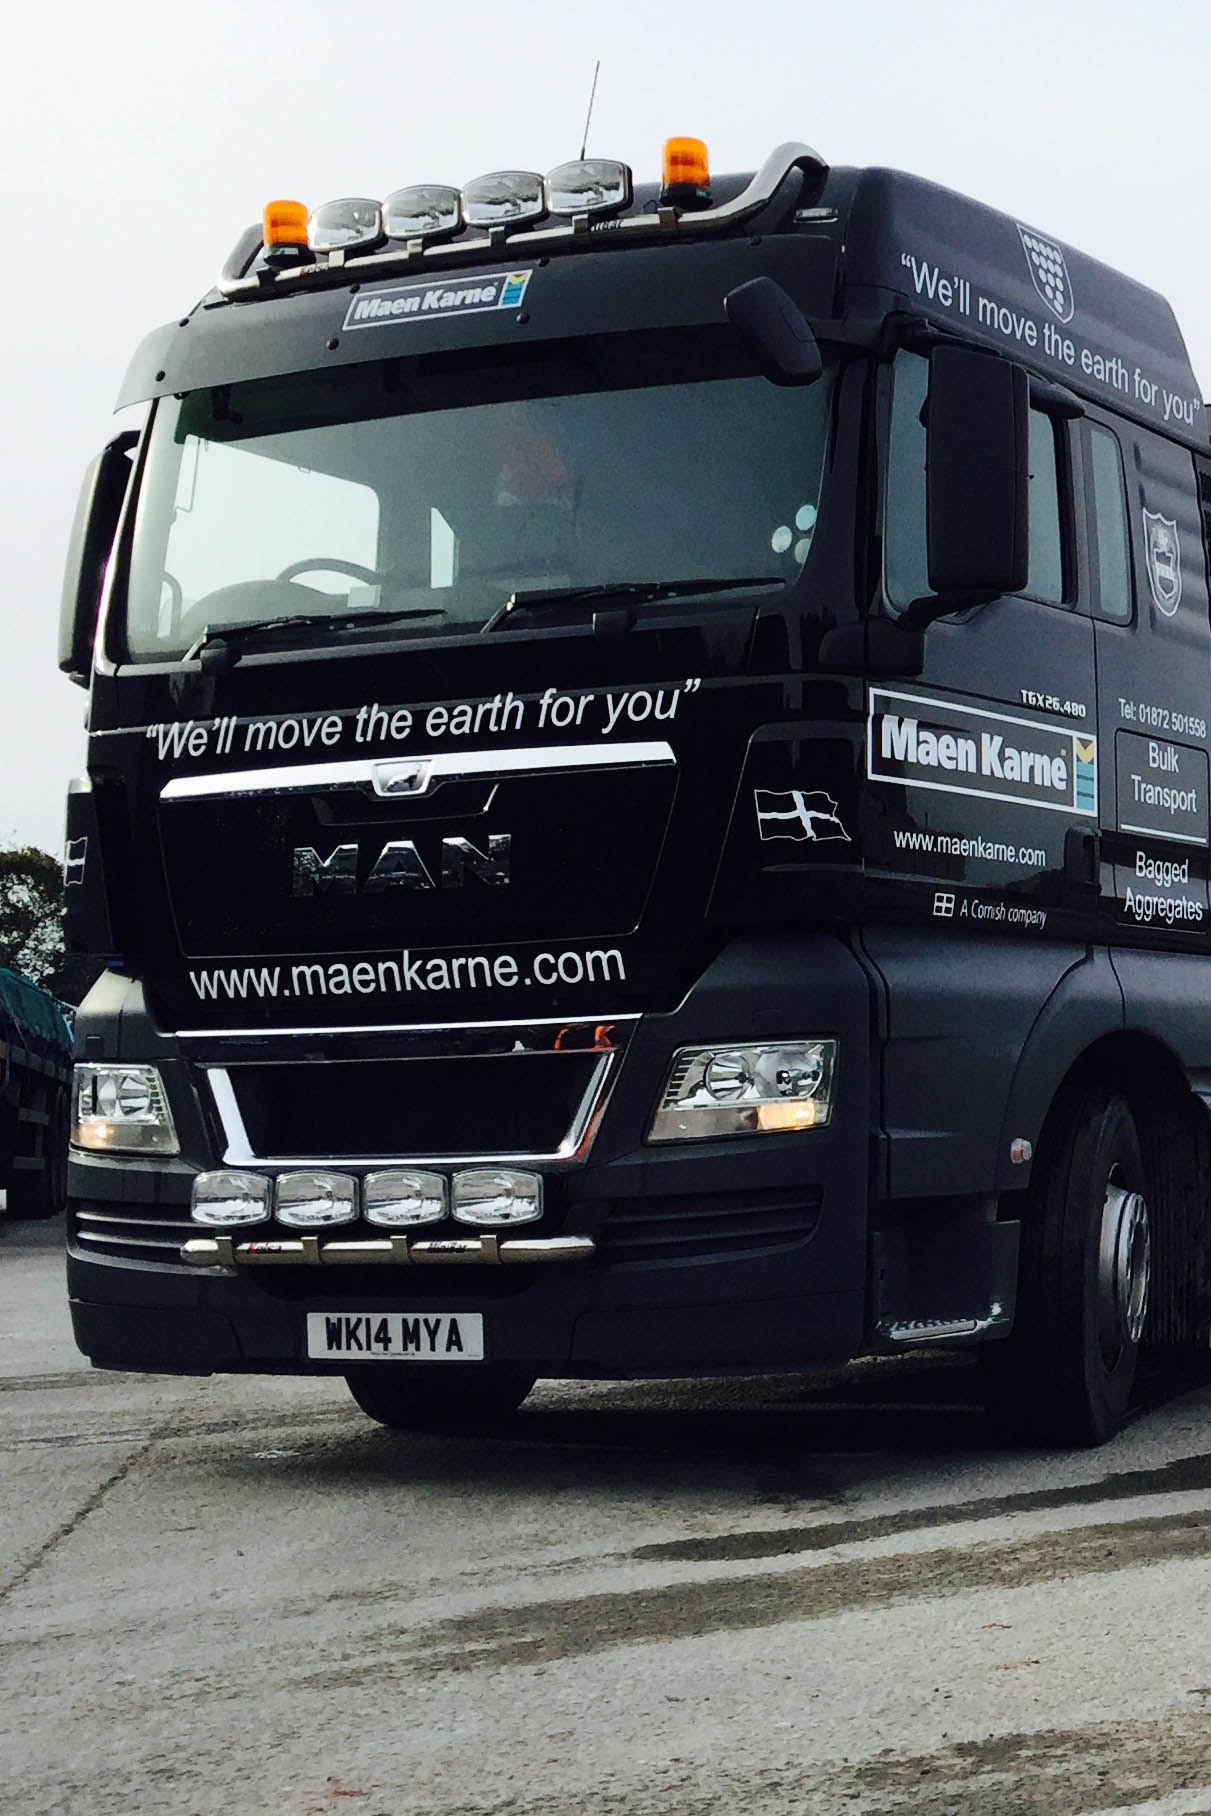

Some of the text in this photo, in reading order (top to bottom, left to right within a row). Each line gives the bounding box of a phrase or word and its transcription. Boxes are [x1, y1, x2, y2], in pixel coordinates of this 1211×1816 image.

[353, 285, 497, 320] Maen Karne
[901, 253, 1200, 425] “We’ll move the earth for you”
[146, 678, 701, 760] “We’ll move the earth for you”
[1118, 697, 1206, 738] Tel: 01872 501558
[881, 714, 1068, 790] Maen Karne
[1149, 741, 1179, 773] Bulk
[1131, 774, 1197, 815] Transport
[290, 834, 512, 896] MAN
[894, 830, 1046, 867] www.maenkarne.com
[1136, 850, 1189, 888] Bagged
[960, 899, 1047, 930] A Cornish company
[1124, 886, 1203, 924] Aggregates
[189, 949, 627, 1000] www.maenkarne.com
[325, 1316, 464, 1353] WK14 MYA
